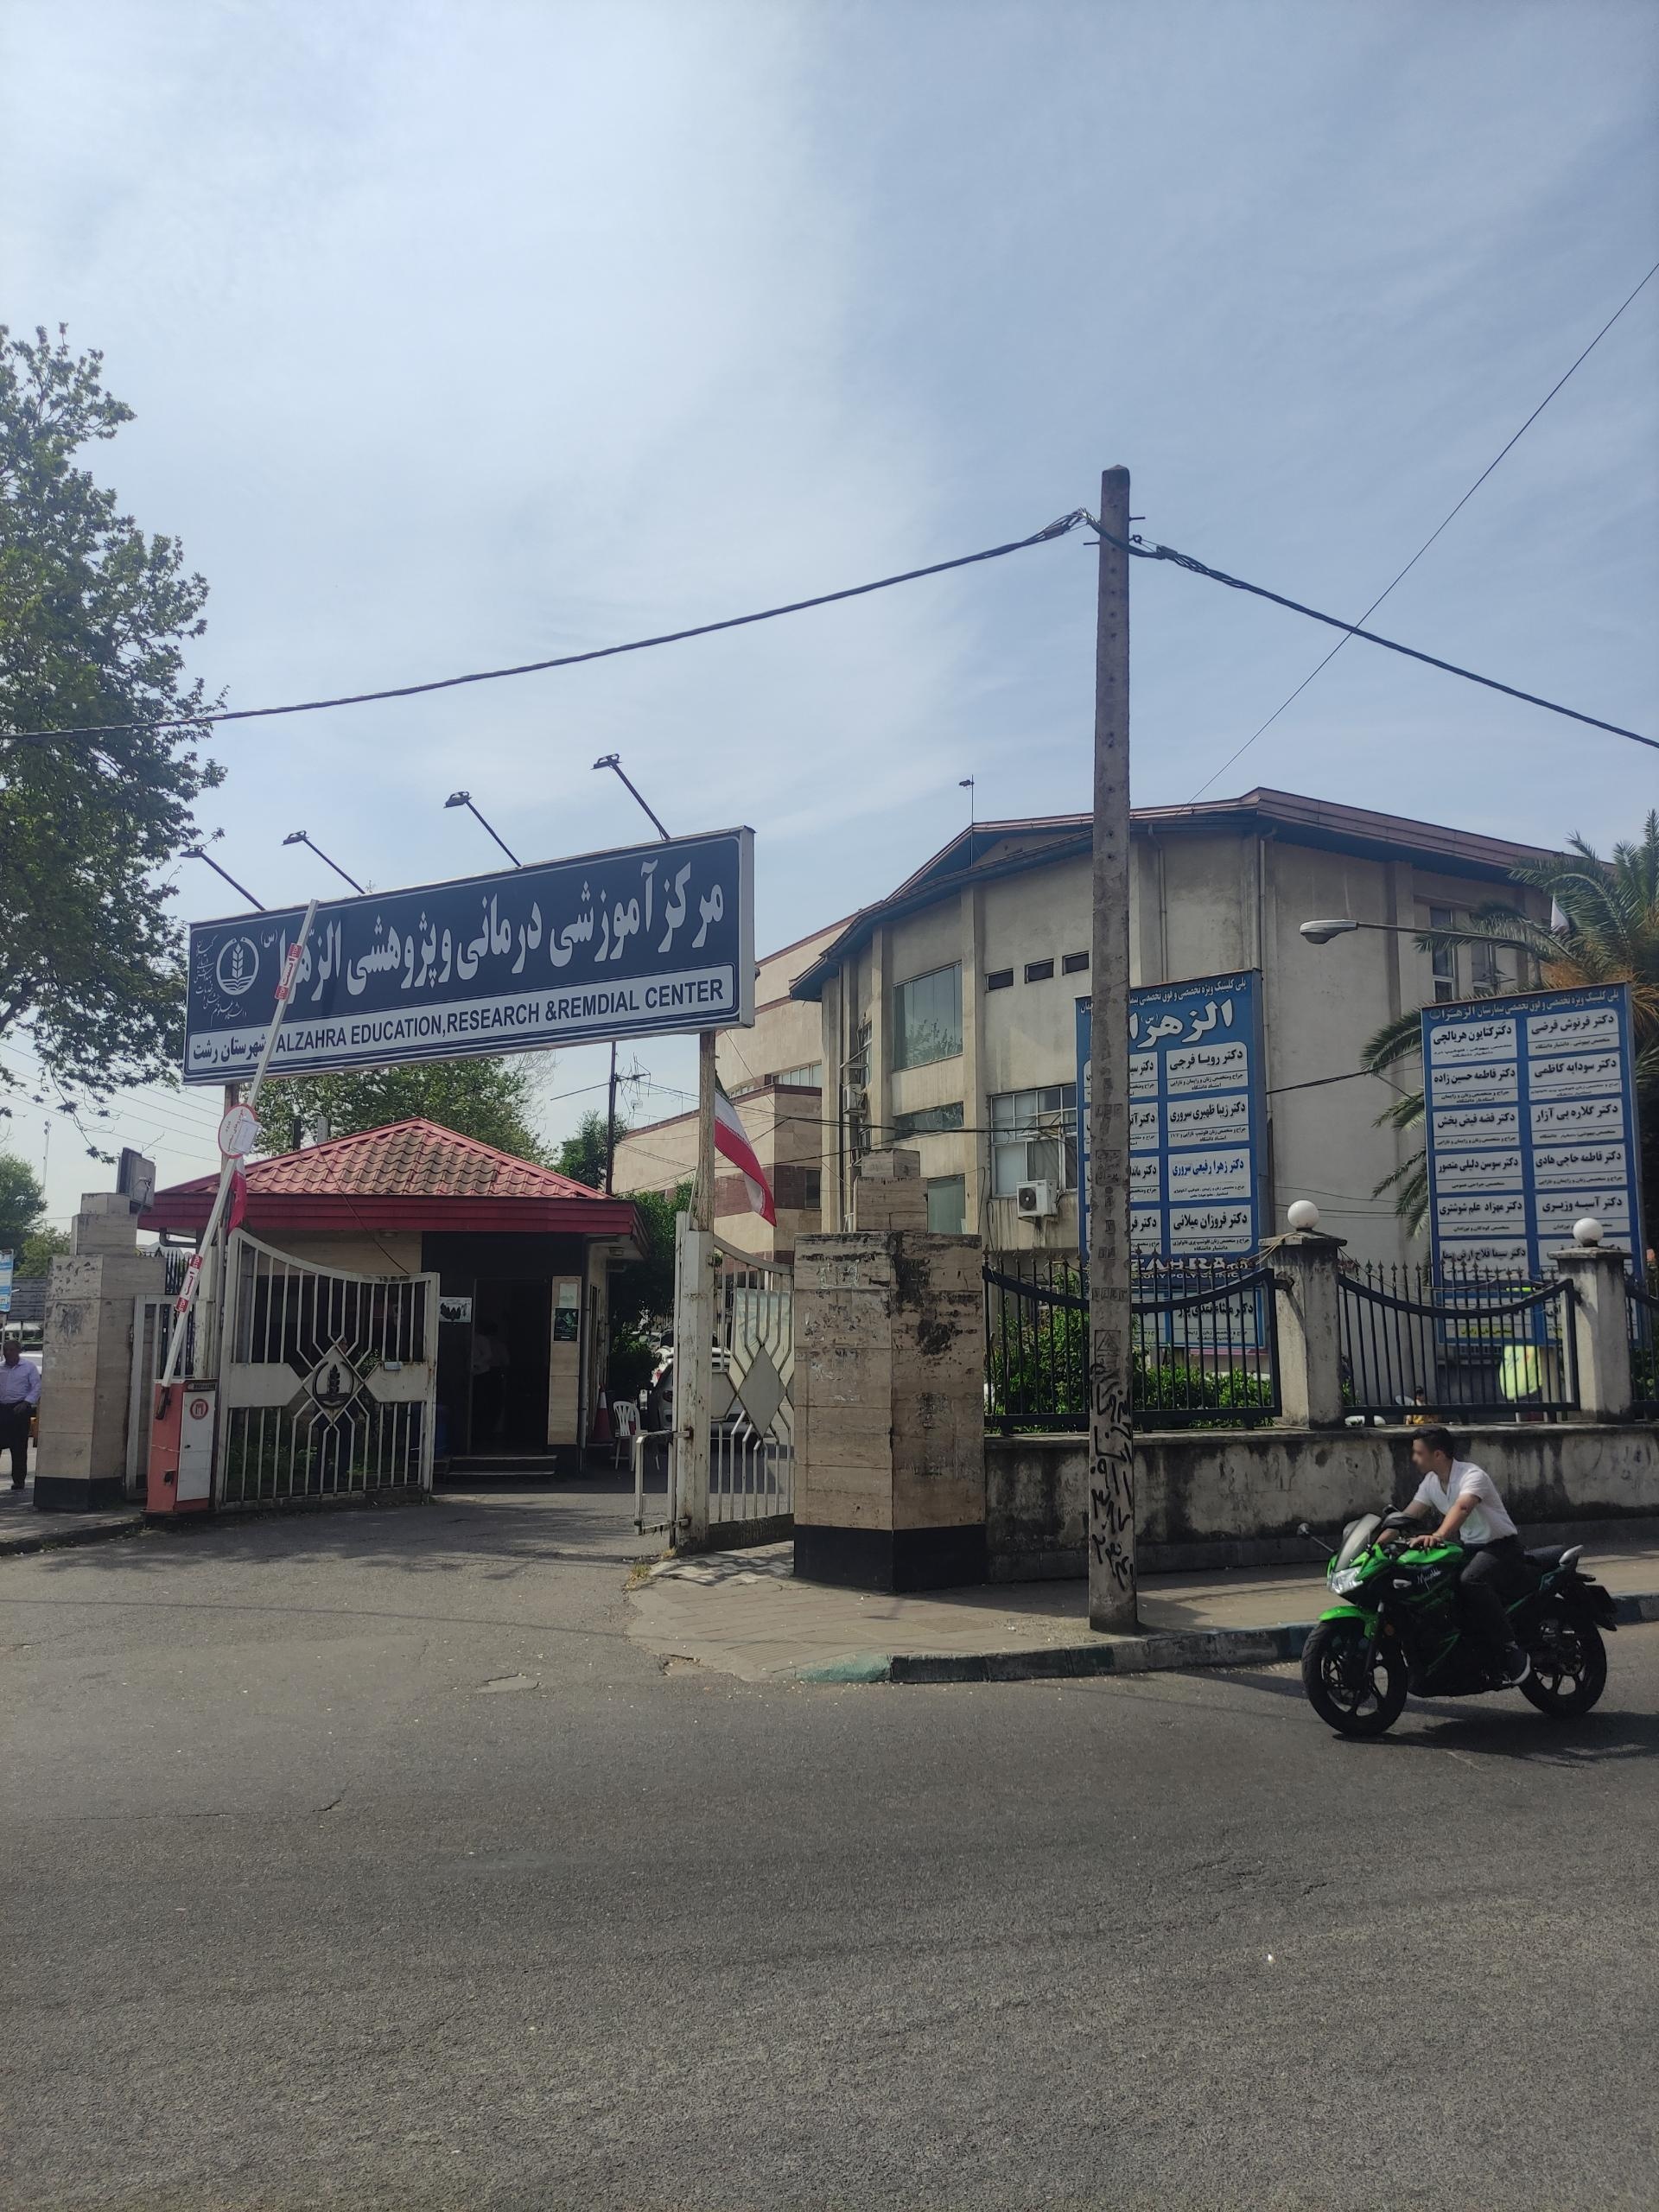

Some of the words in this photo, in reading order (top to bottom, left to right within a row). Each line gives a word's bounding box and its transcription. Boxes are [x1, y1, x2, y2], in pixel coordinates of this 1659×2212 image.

[550, 859, 658, 968] آموزشی
[658, 861, 724, 954] مرکز
[456, 893, 543, 980] درمانی
[276, 1027, 346, 1053] ALZAHRA
[645, 978, 724, 1009] CENTER
[1592, 1014, 1614, 1028] دکتر
[1129, 998, 1233, 1048] الزهرا
[1531, 1020, 1558, 1034] فرضی
[1560, 1015, 1591, 1031] فرنوش
[1493, 1025, 1512, 1039] دکتر
[193, 1039, 219, 1064] رشت
[1223, 1049, 1243, 1065] دکتر
[1140, 1059, 1154, 1075] دکتر
[1169, 1053, 1195, 1071] فرجی
[1566, 1061, 1594, 1074] سودابه
[1596, 1058, 1617, 1071] دکتر
[1474, 1068, 1497, 1079] فاطمه
[1497, 1068, 1516, 1081] دکتر
[1534, 1063, 1564, 1077] کاظمی
[1433, 1072, 1450, 1085] زاده
[1451, 1074, 1472, 1084] حسین
[1192, 1104, 1215, 1120] ظهیری
[1217, 1103, 1229, 1117] زیبا
[1230, 1102, 1246, 1116] دکتر
[1535, 1107, 1554, 1122] آزار
[1556, 1109, 1569, 1121] بی
[1596, 1103, 1618, 1117] دکتر
[1139, 1112, 1155, 1127] دکتر
[1169, 1111, 1192, 1122] سروری
[1437, 1116, 1458, 1128] بخش
[1459, 1114, 1478, 1127] فیض
[1496, 1112, 1515, 1125] دکتر
[1502, 1157, 1518, 1170] دکتر
[1535, 1155, 1554, 1167] هادی
[1556, 1153, 1579, 1167] حاجی
[1580, 1151, 1602, 1162] فاطمه
[1604, 1150, 1622, 1164] دکتر
[1142, 1164, 1157, 1179] دکتر
[1172, 1165, 1192, 1176] سروری
[1192, 1160, 1212, 1175] رفیعی
[1213, 1159, 1228, 1173] زهرا
[1229, 1159, 1244, 1173] دکتر
[1459, 1159, 1479, 1172] دلیلی
[1439, 1203, 1467, 1215] شوشتری
[1505, 1201, 1522, 1213] دکتر
[1542, 1201, 1573, 1211] وزیری
[1574, 1196, 1600, 1210] آسیه
[1603, 1197, 1623, 1210] دکتر
[1140, 1217, 1156, 1231] دکتر
[1173, 1213, 1198, 1230] میلانی
[1200, 1211, 1227, 1229] فروزان
[1229, 1211, 1248, 1228] دکتر
[1510, 1247, 1526, 1260] دکتر
